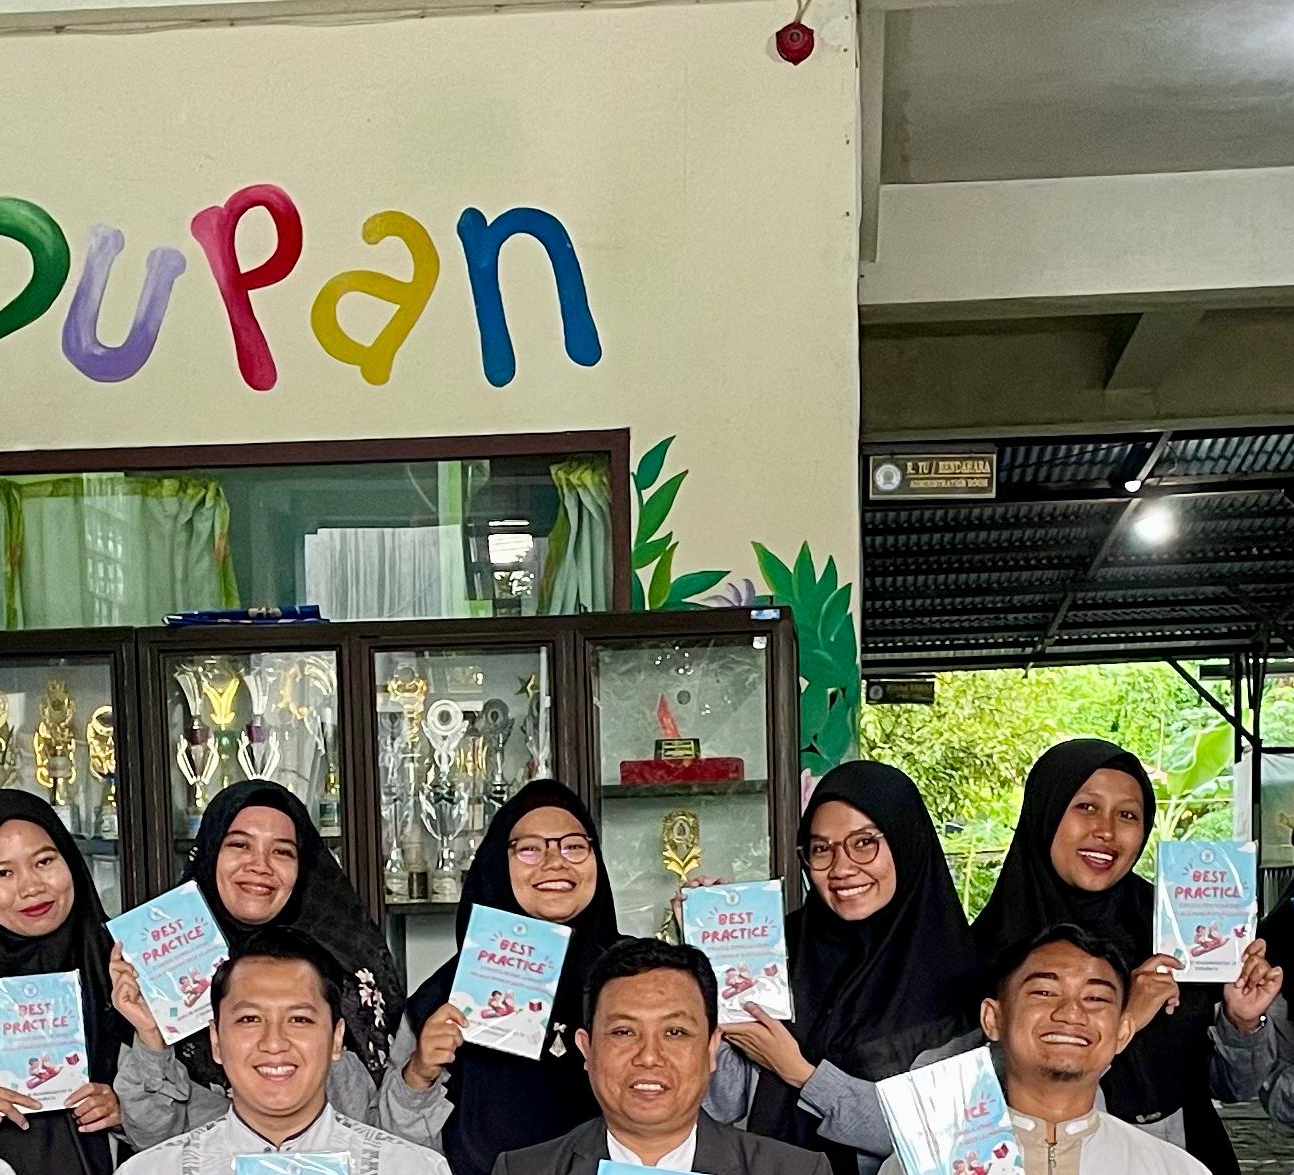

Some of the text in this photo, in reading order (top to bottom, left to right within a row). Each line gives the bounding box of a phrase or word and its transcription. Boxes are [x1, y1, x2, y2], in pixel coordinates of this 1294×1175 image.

[1192, 870, 1227, 882] BEST
[718, 912, 753, 926] BEST
[151, 919, 184, 941] BEST
[701, 926, 769, 944] PRACTICE
[142, 926, 205, 966] PRACTICE
[500, 938, 536, 957] BEST
[477, 950, 546, 975] PRACTICE
[18, 1002, 51, 1016] BEST
